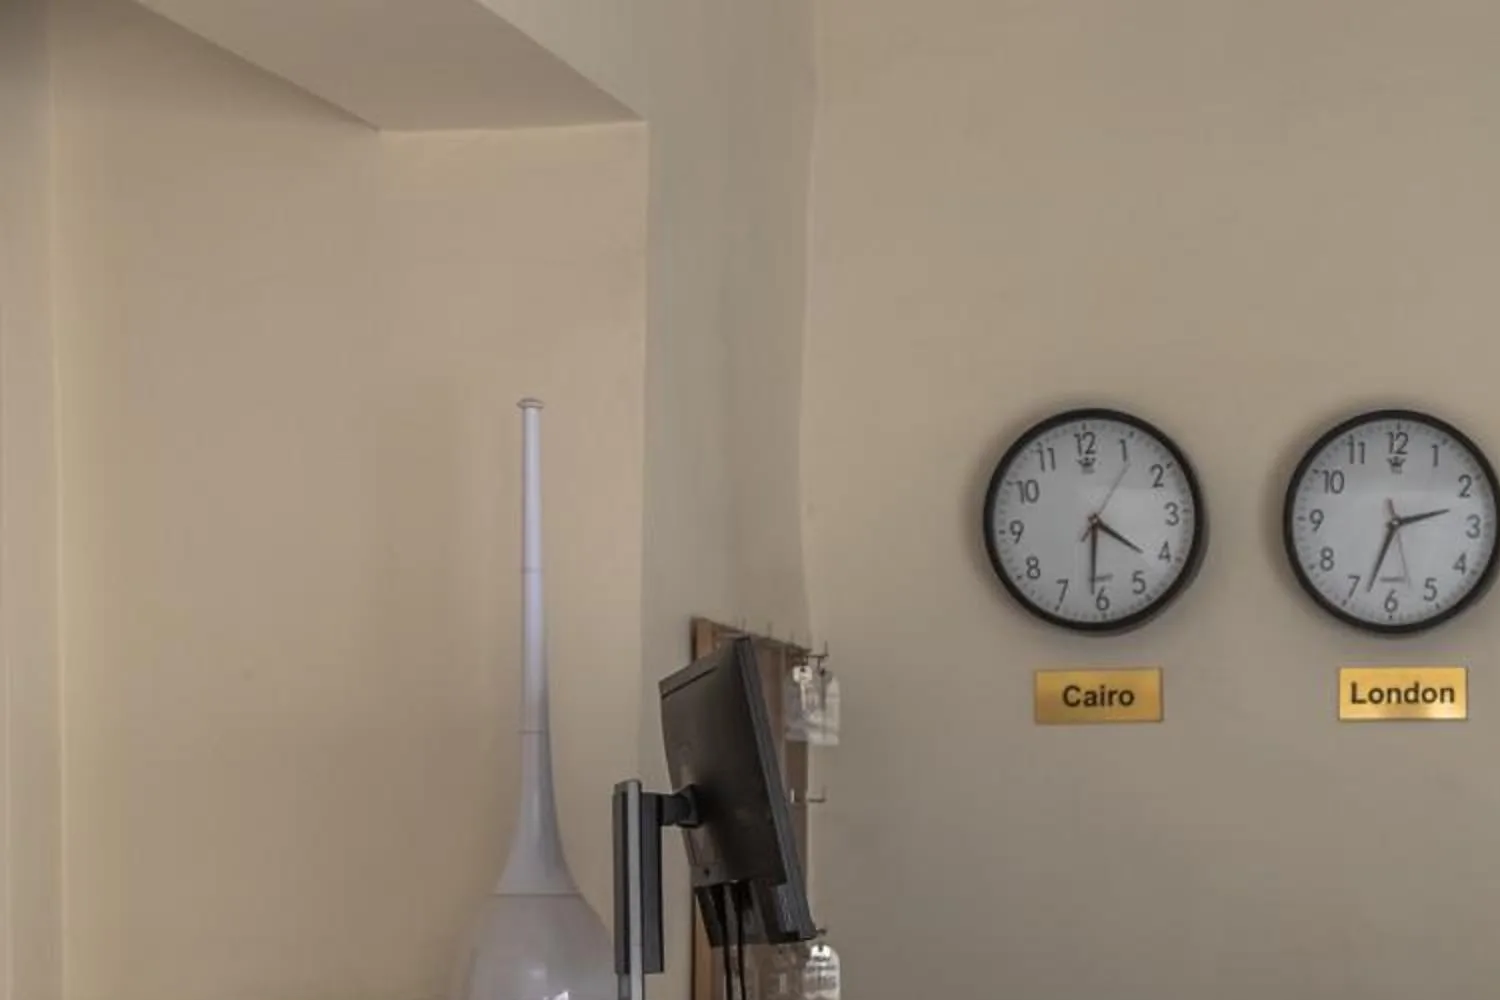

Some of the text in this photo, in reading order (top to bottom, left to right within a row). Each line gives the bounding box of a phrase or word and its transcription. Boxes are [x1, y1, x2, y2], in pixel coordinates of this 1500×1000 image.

[1073, 431, 1096, 456] 12
[1118, 438, 1128, 463] 1
[1346, 440, 1366, 465] 11
[1386, 431, 1410, 456] 12
[1431, 443, 1439, 468] 1
[1036, 446, 1057, 473] 11
[1149, 463, 1165, 489] 2
[1321, 469, 1346, 495] 10
[1457, 473, 1473, 499] 2
[1016, 478, 1040, 505] 10
[1163, 501, 1180, 527] 3
[1308, 508, 1325, 533] 9
[1465, 514, 1482, 539] 3
[1009, 519, 1025, 545] 9
[1157, 540, 1172, 564] 4
[1319, 546, 1335, 572] 8
[1452, 552, 1467, 576] 4
[1025, 555, 1041, 580] 8
[1056, 578, 1070, 604] 7
[1131, 570, 1147, 595] 5
[1347, 575, 1361, 600] 7
[1423, 577, 1438, 602] 5
[1095, 586, 1111, 612] 6
[1383, 588, 1399, 614] 6
[1062, 684, 1135, 708] Cairo
[1350, 680, 1456, 705] London
